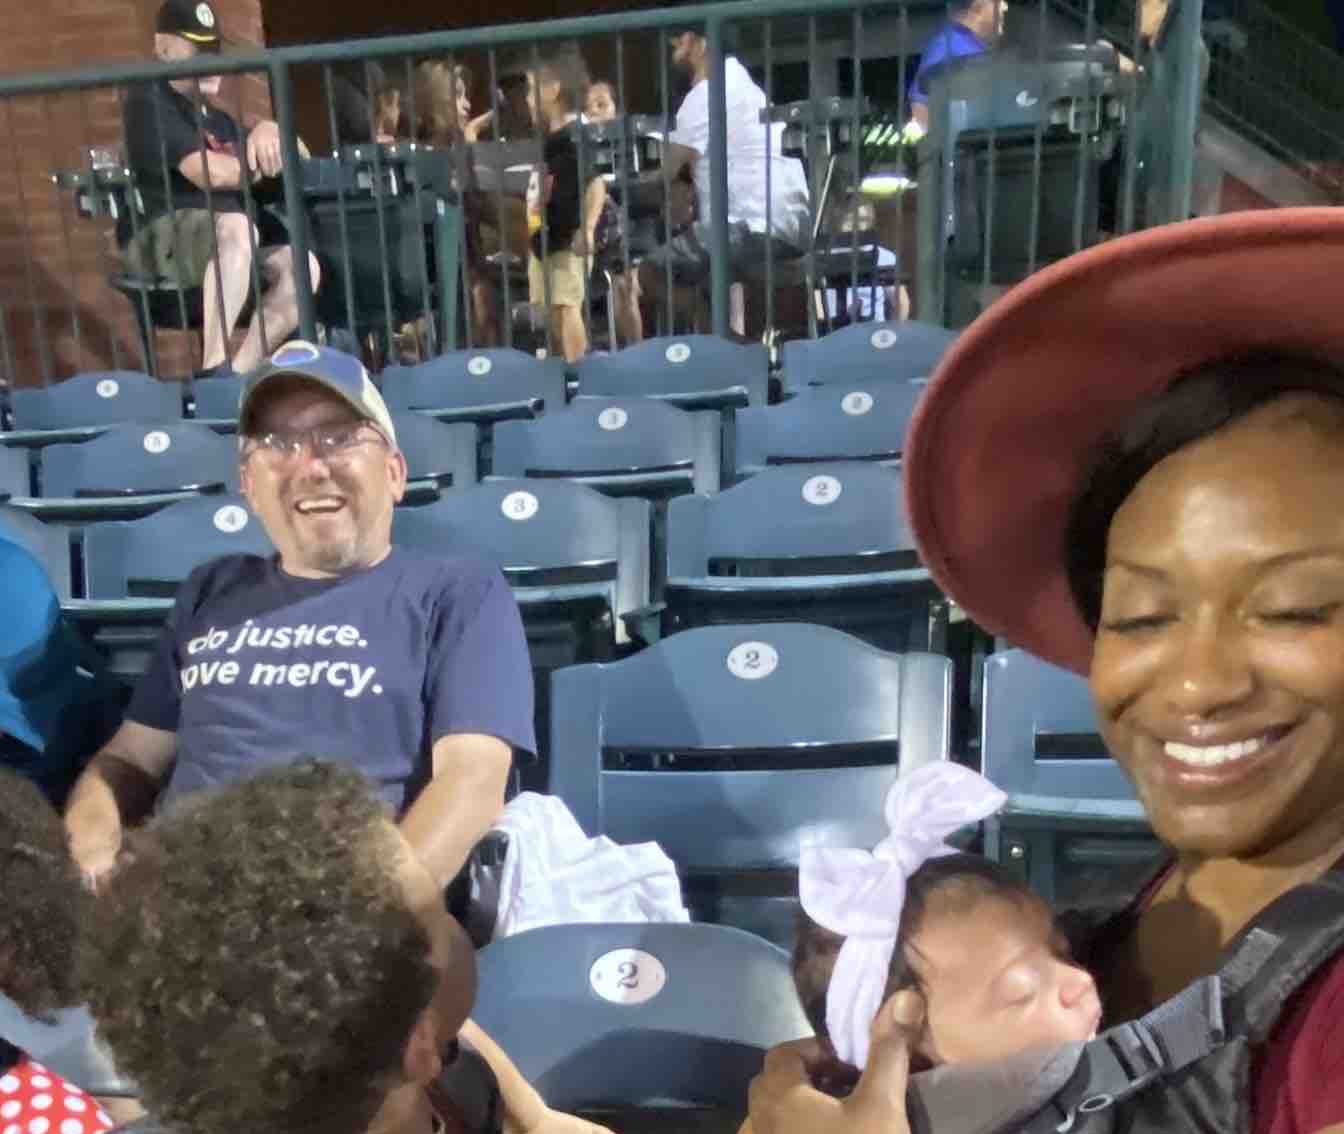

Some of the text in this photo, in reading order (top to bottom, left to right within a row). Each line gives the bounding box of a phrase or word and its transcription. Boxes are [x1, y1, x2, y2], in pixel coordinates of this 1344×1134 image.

[815, 481, 828, 497] 2
[513, 497, 526, 513] 3
[223, 510, 236, 526] 4
[187, 619, 369, 655] do justice.
[744, 649, 761, 670] 2
[180, 660, 384, 698] ove mercy.
[616, 961, 640, 990] 2
